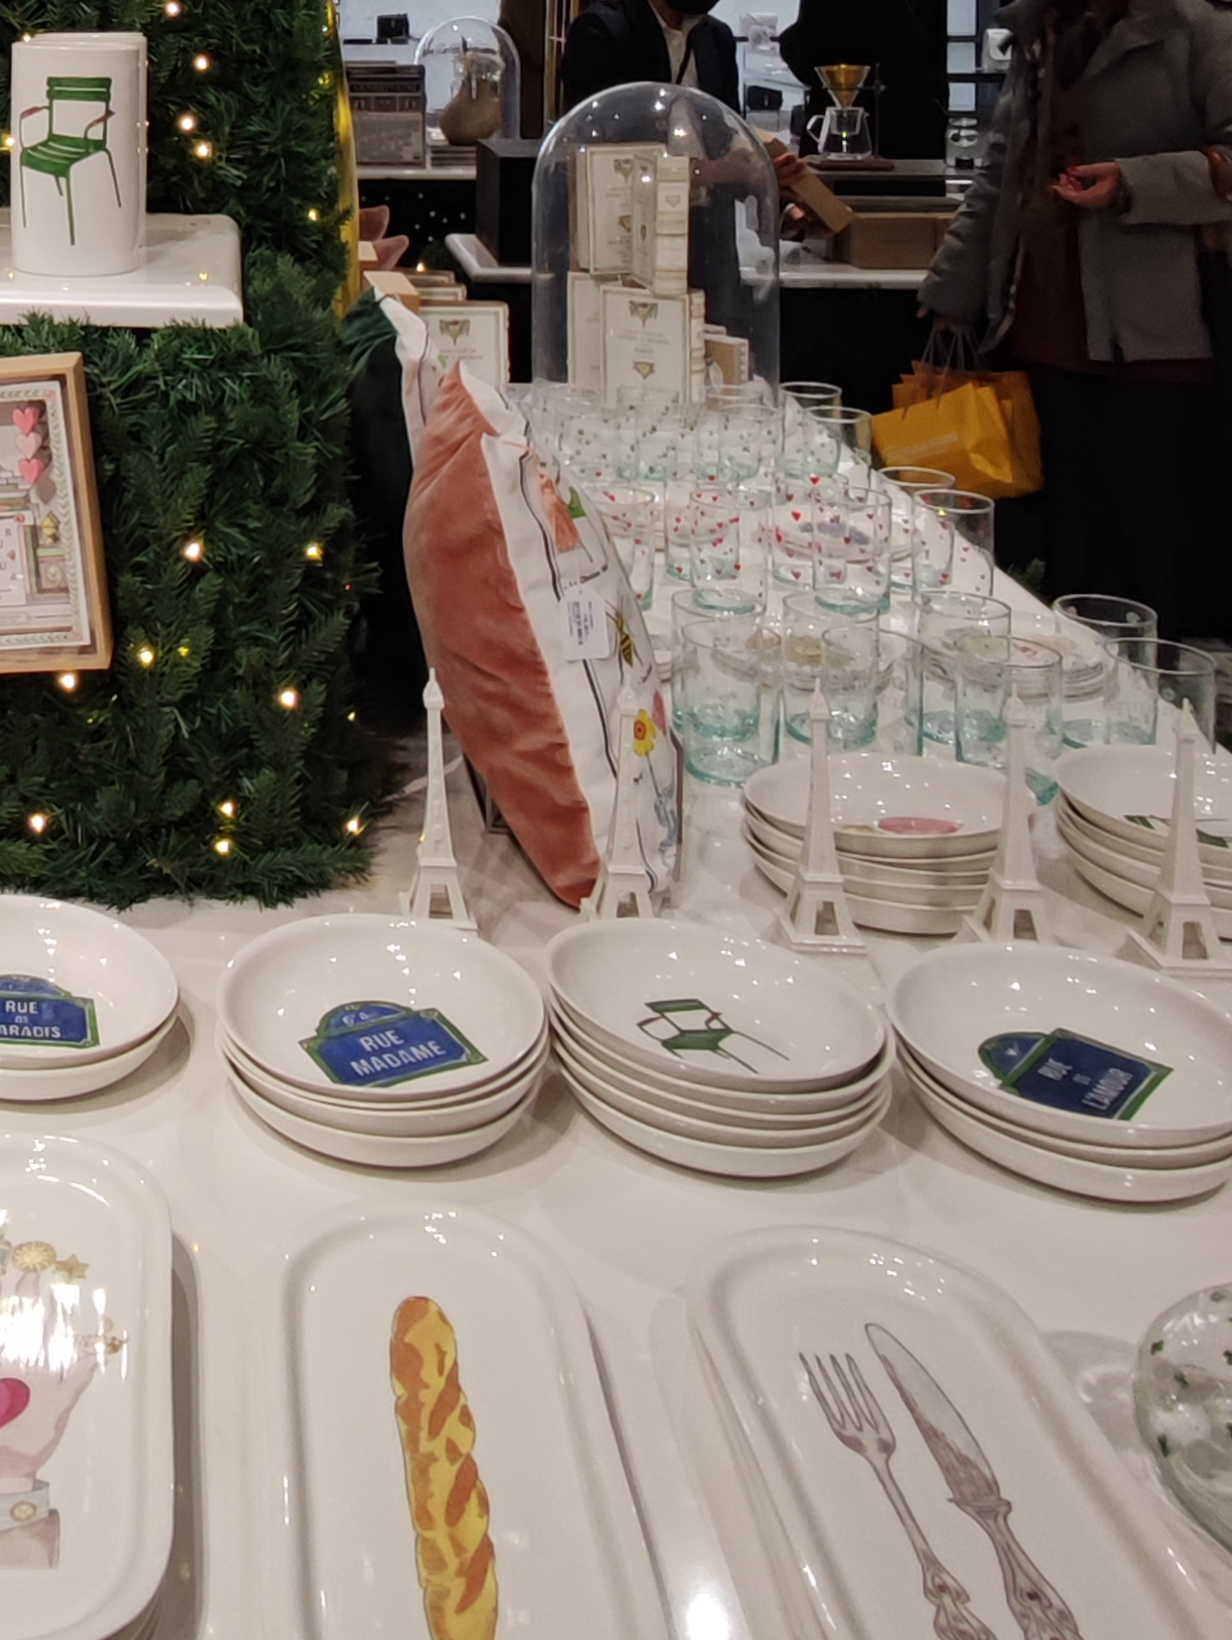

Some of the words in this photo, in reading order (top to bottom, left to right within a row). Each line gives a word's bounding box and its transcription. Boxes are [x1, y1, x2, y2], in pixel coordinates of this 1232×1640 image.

[5, 1000, 39, 1014] RUE
[359, 1030, 404, 1052] RUE
[350, 1040, 447, 1077] MADAME
[1037, 1058, 1073, 1081] RUE
